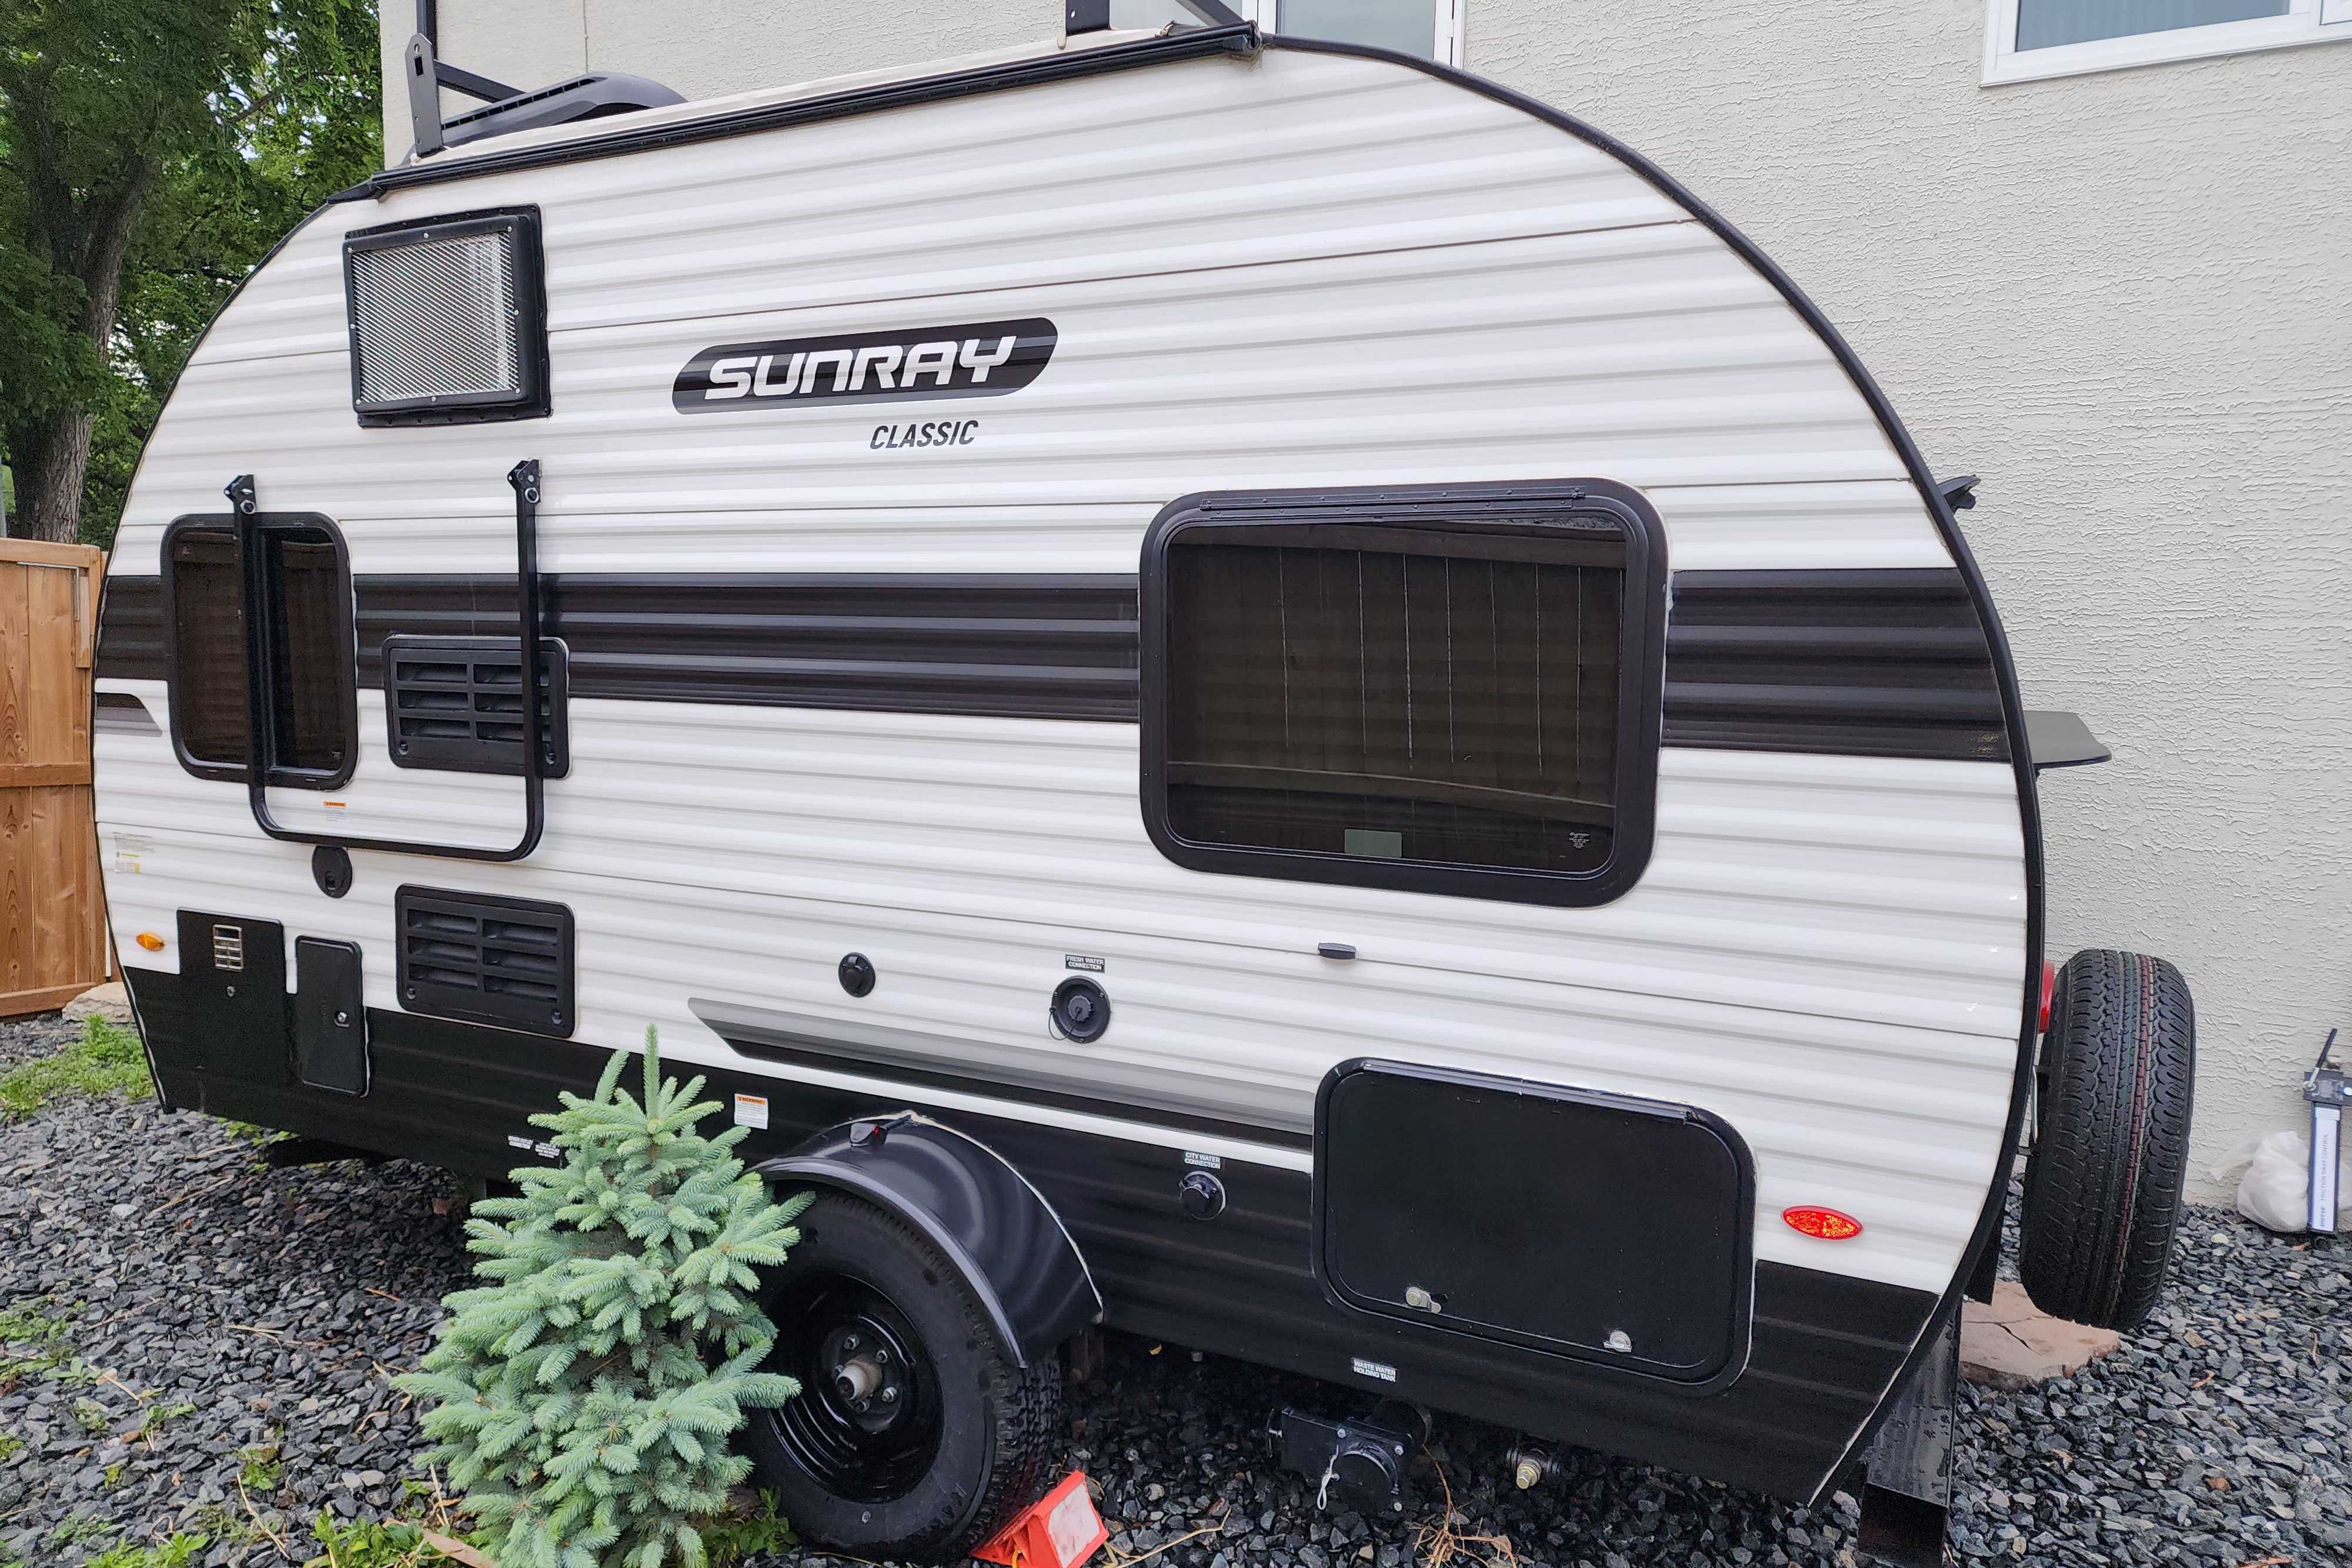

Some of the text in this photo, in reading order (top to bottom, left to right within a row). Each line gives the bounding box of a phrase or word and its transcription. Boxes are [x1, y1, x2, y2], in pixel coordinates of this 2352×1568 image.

[704, 336, 1017, 400] SUNRAY
[870, 419, 979, 450] CLASSIC
[1068, 961, 1102, 971] CONNECTION
[1085, 957, 1104, 965] WATER
[1184, 1158, 1221, 1169] CONNECTION
[1199, 1154, 1221, 1164] WATER
[1354, 1359, 1396, 1376] WASTE WATER
[1354, 1366, 1396, 1383] HOLDING TANK
